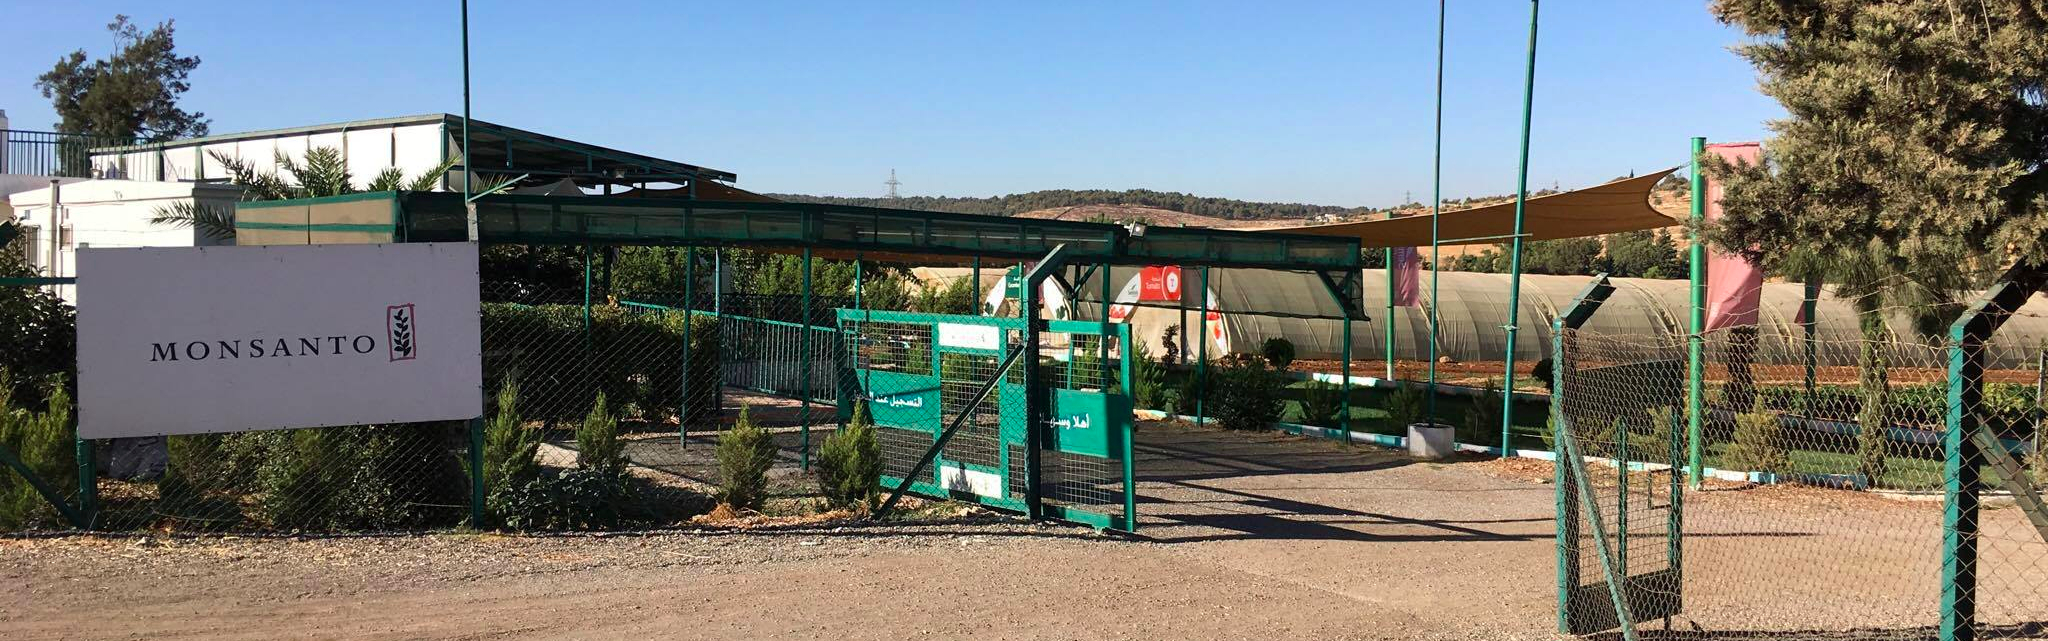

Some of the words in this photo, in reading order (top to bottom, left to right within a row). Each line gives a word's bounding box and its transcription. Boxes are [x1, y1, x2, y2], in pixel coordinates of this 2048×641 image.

[150, 335, 375, 361] MONSANTO
[875, 394, 889, 403] عند
[890, 394, 922, 407] التسجيل
